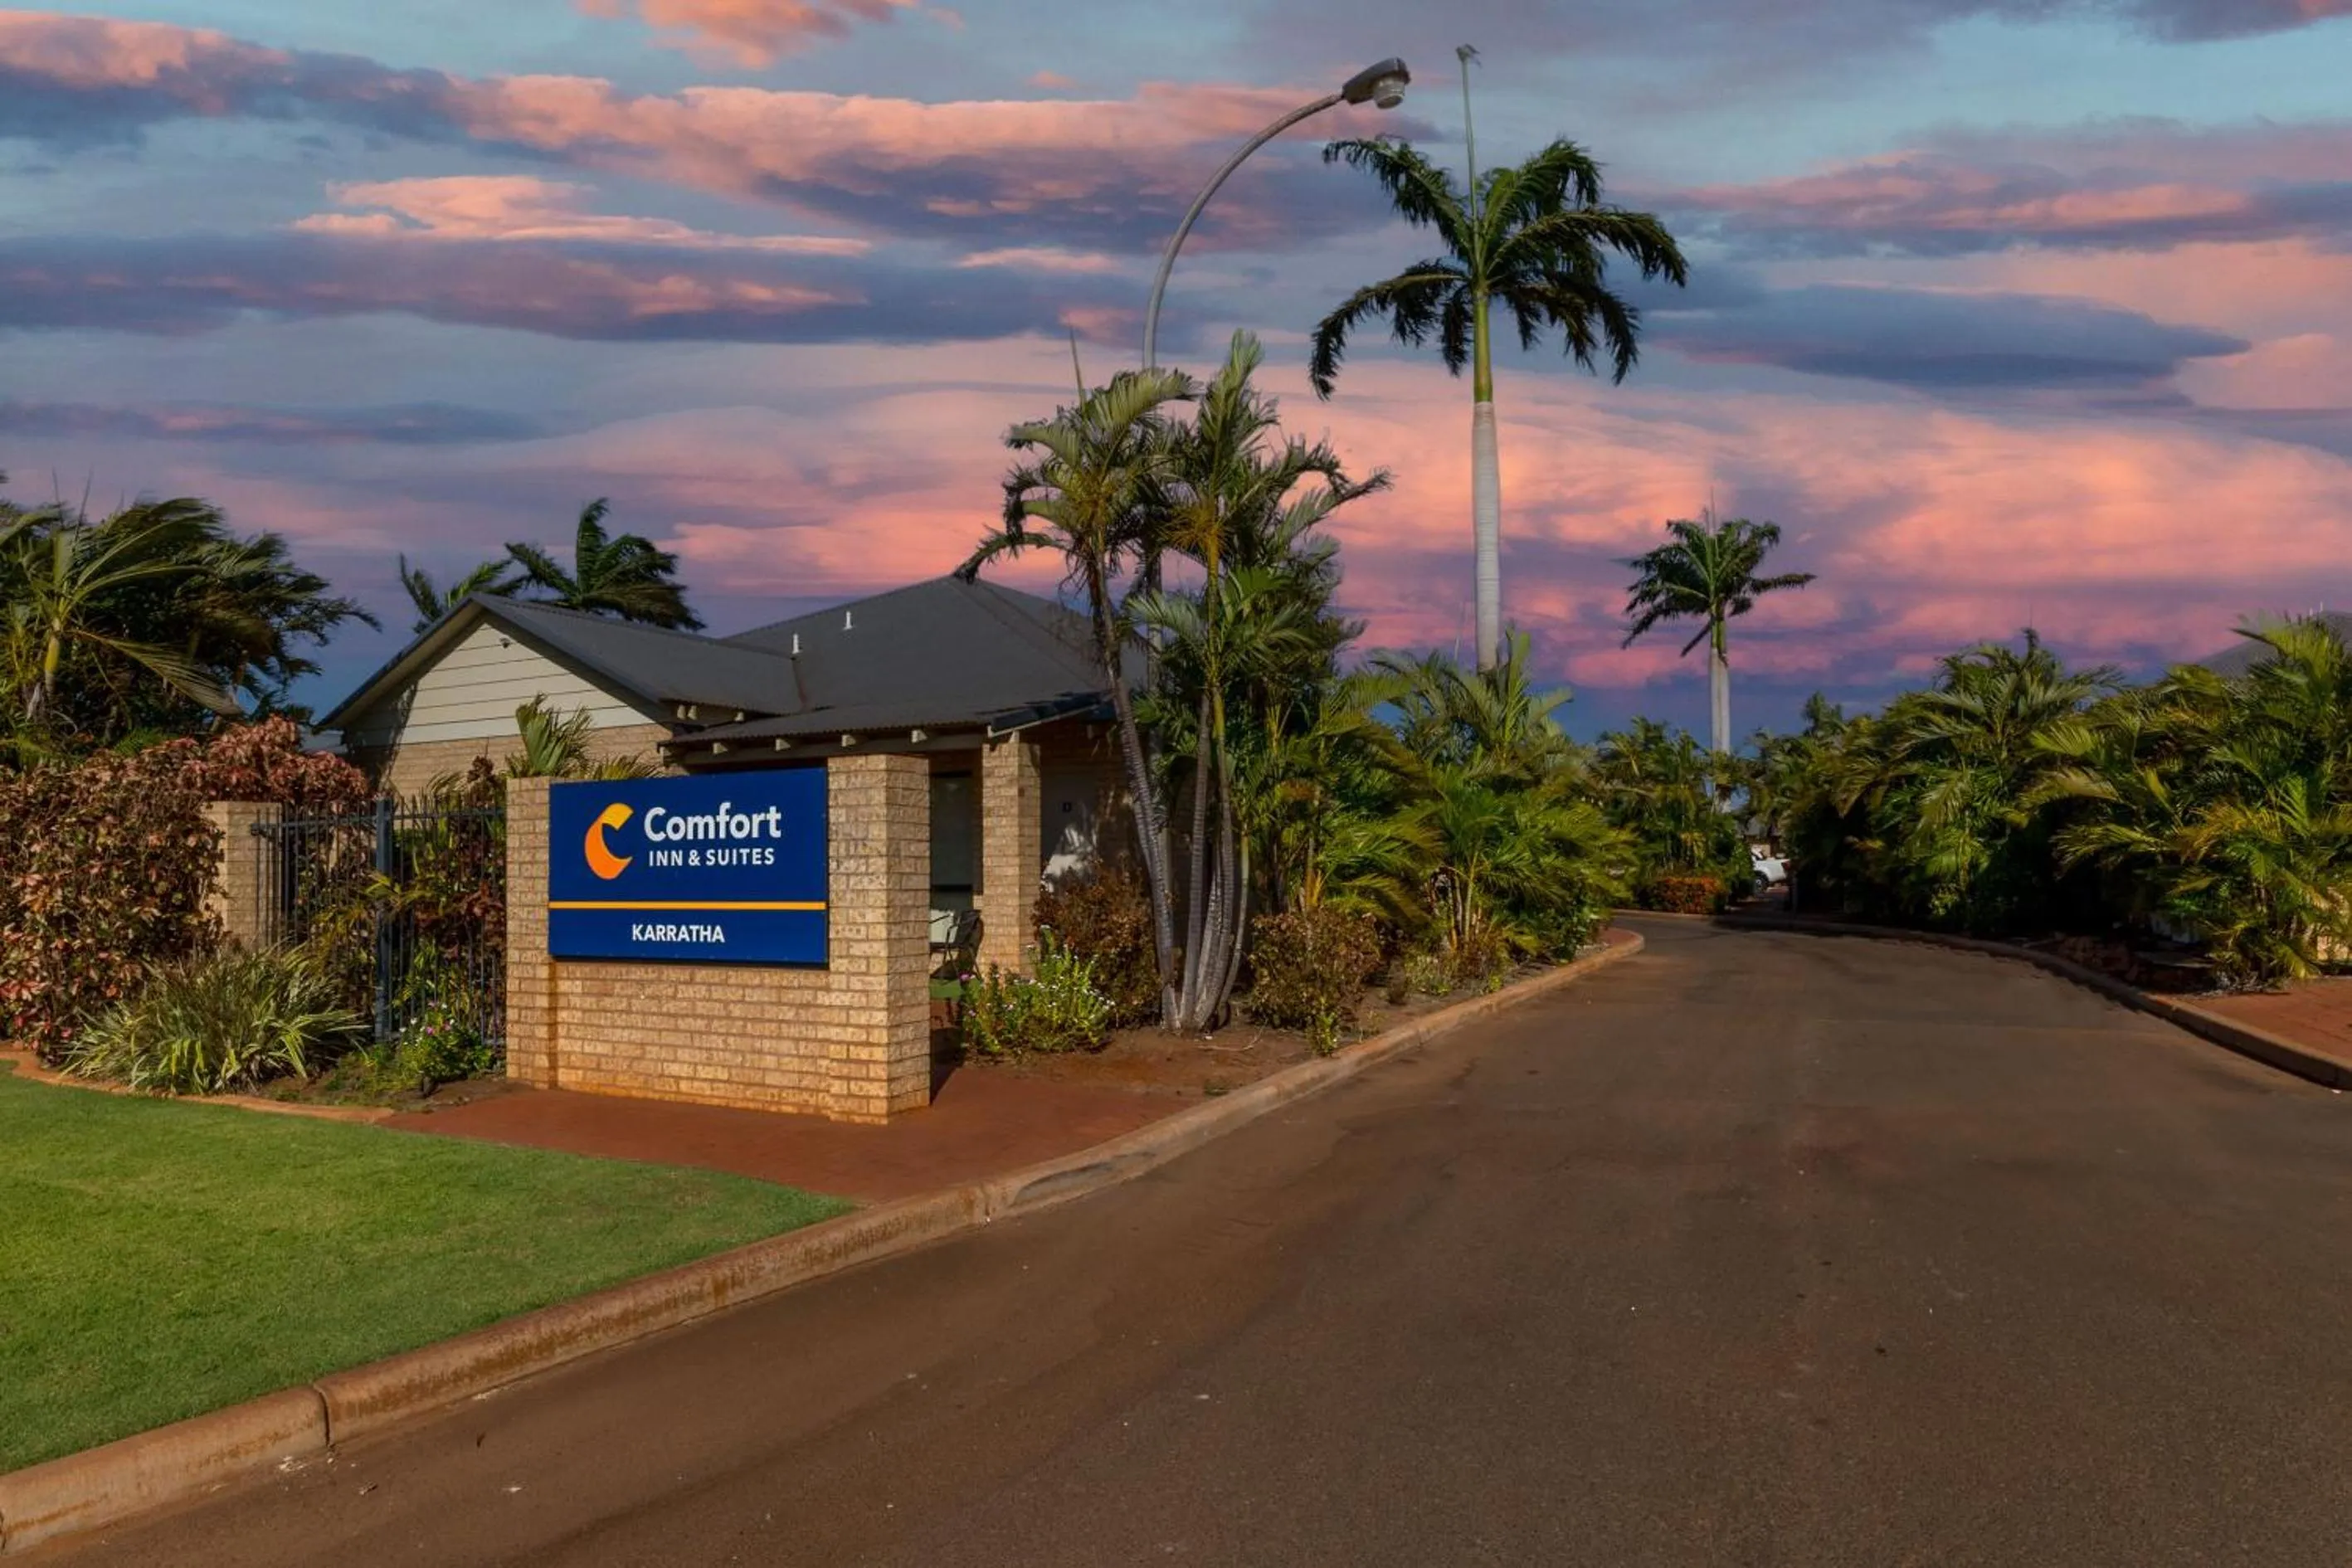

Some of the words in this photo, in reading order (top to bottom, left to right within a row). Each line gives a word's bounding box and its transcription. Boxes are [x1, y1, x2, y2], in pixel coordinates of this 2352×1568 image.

[644, 801, 782, 841] Comfort
[649, 850, 684, 867] INN
[688, 849, 701, 867] &
[705, 847, 775, 866] SUITES
[631, 923, 726, 943] KARRATHA
